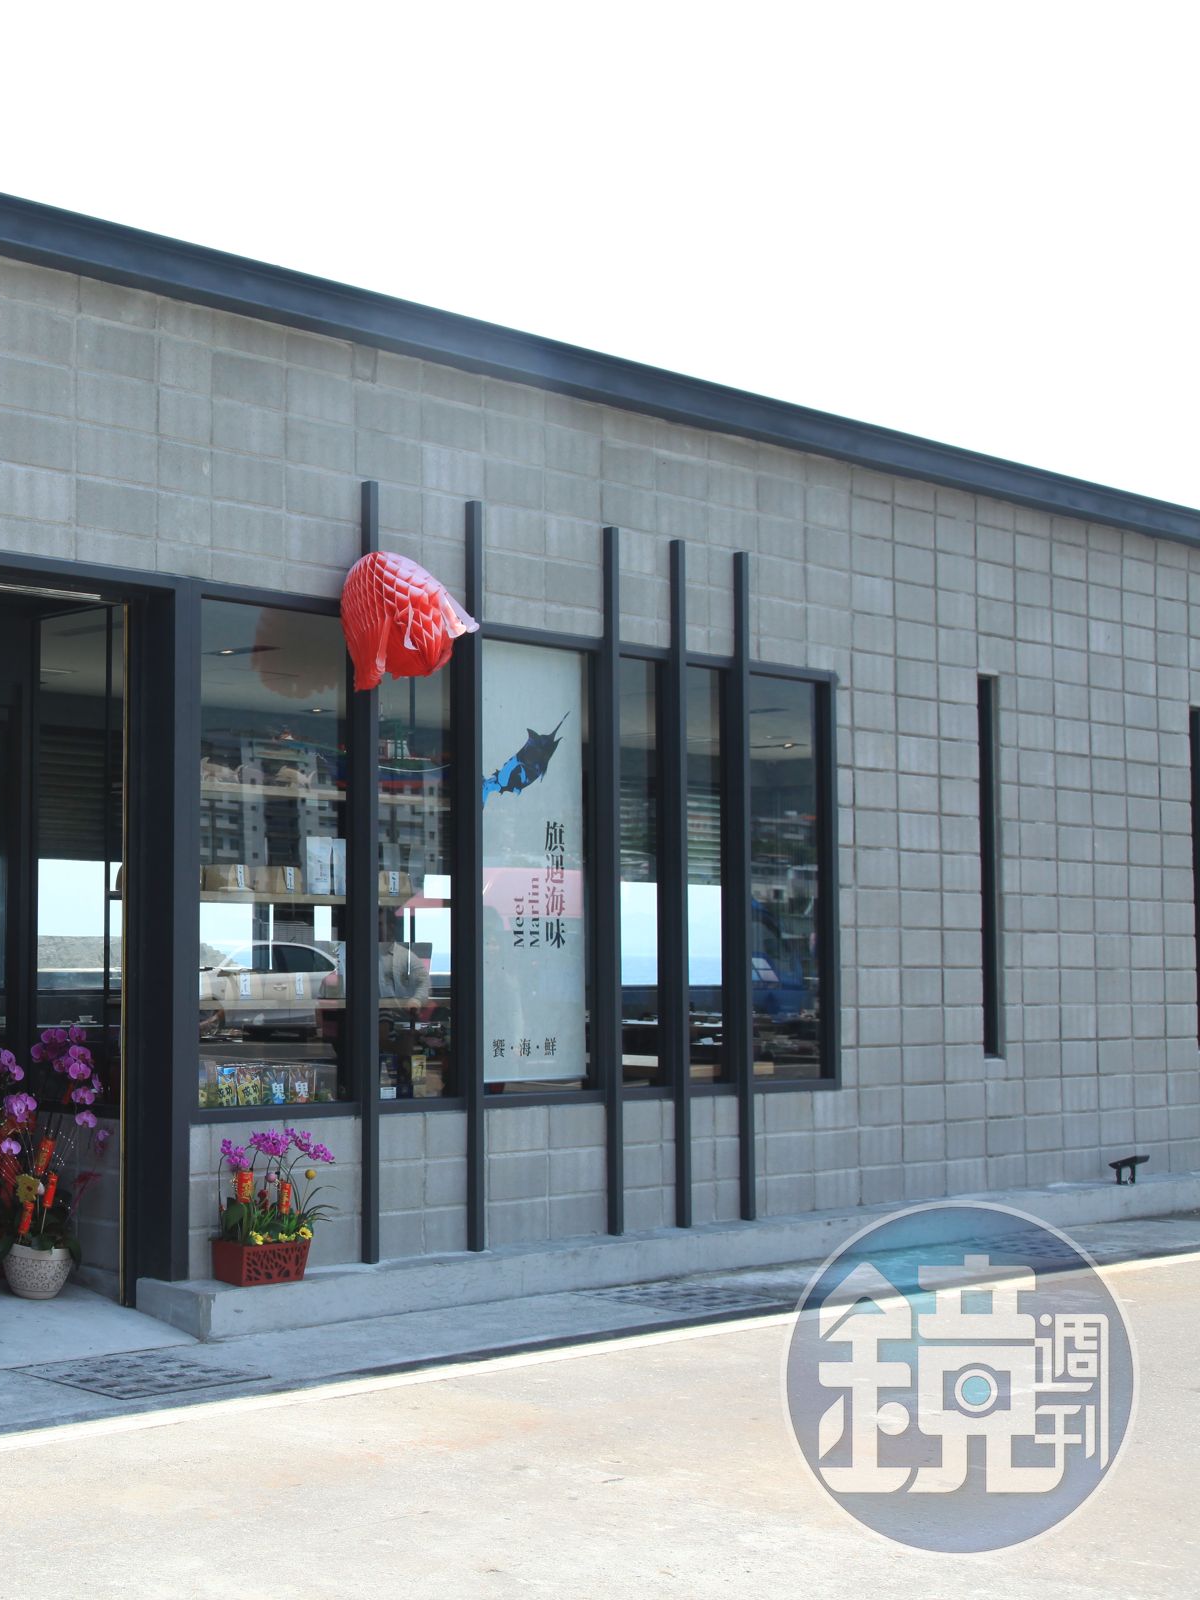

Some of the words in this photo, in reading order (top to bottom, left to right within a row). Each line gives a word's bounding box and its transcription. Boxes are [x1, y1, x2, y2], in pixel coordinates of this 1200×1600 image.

[544, 820, 566, 949] 旗遇海味
[513, 896, 525, 948] Meet
[528, 877, 540, 948] Marlin
[271, 1082, 286, 1100] 鬼
[295, 1080, 309, 1098] 鬼
